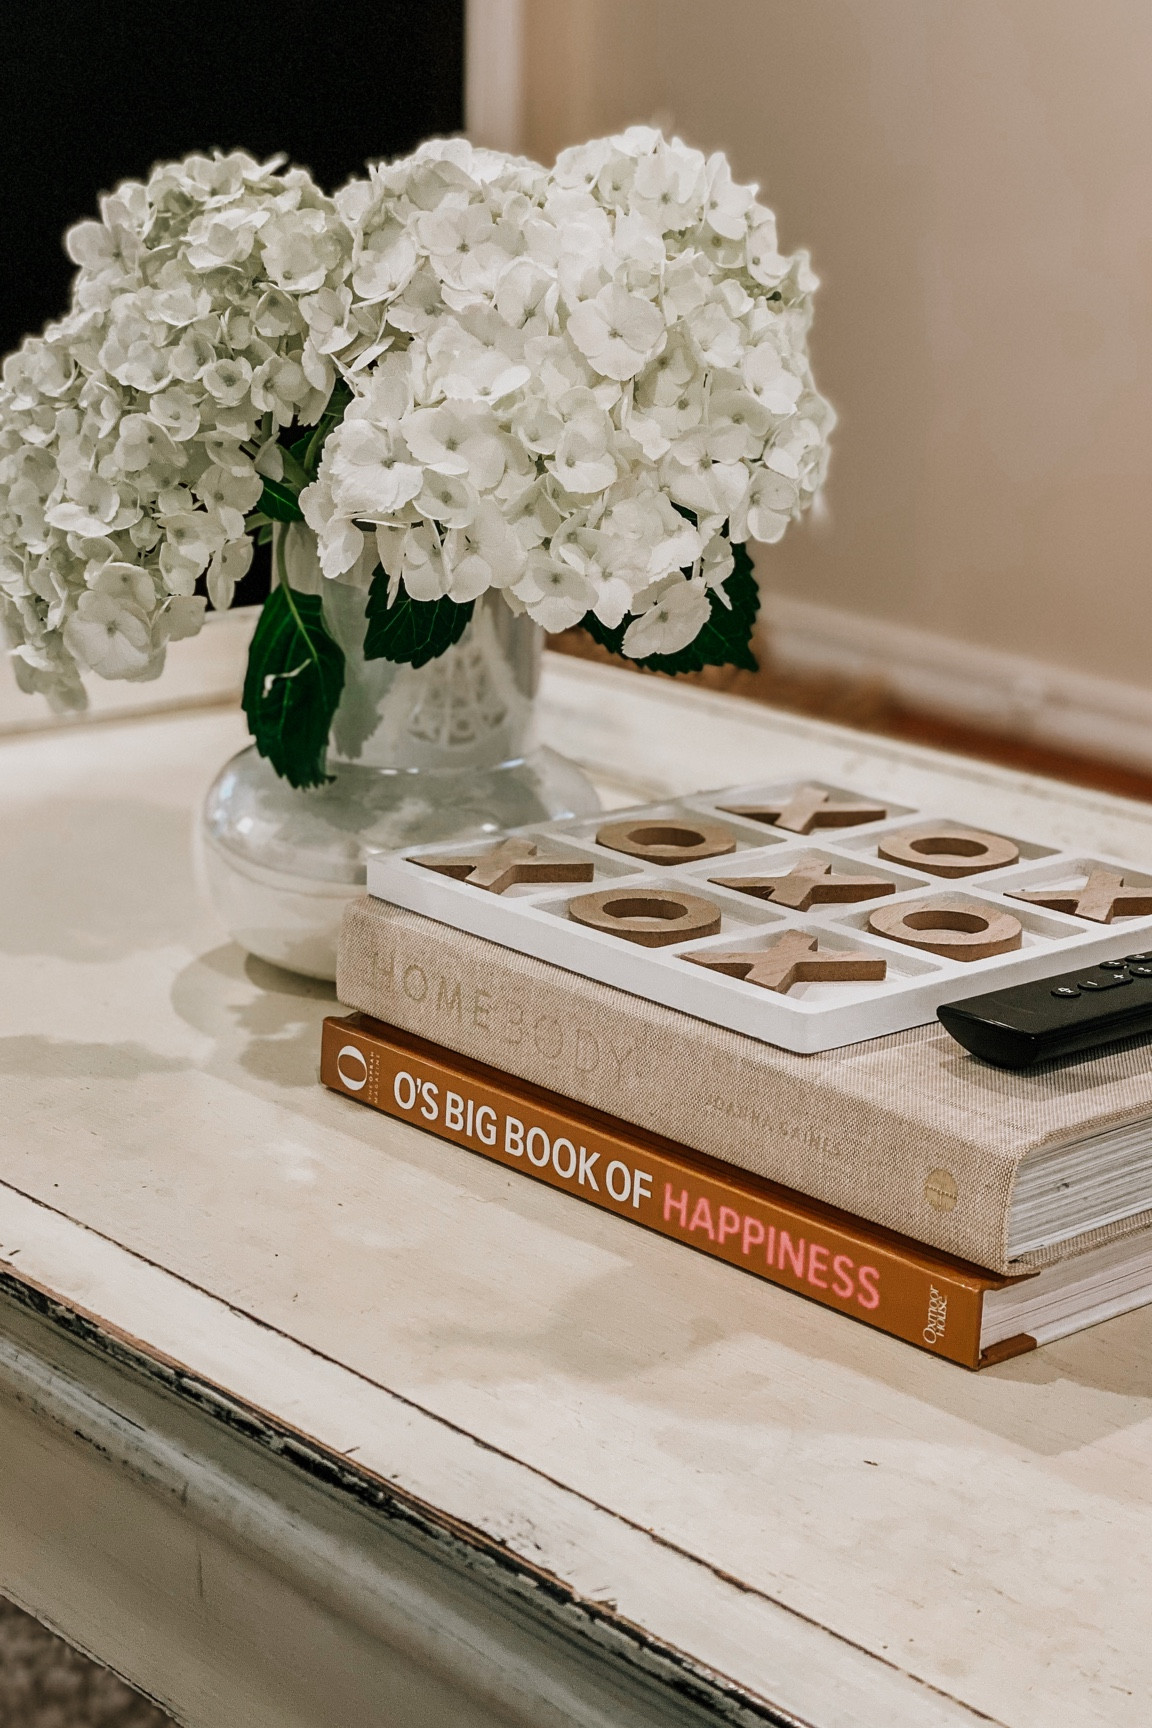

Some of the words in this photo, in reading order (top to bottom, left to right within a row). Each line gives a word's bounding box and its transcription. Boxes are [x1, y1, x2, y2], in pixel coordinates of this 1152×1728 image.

[371, 950, 634, 1086] HOMEBODY
[336, 1045, 368, 1091] O
[445, 1090, 498, 1146] BIG
[504, 1115, 601, 1192] BOOK
[605, 1160, 653, 1209] OF
[662, 1183, 881, 1309] HAPPINESS
[923, 1284, 940, 1344] Oxmoor
